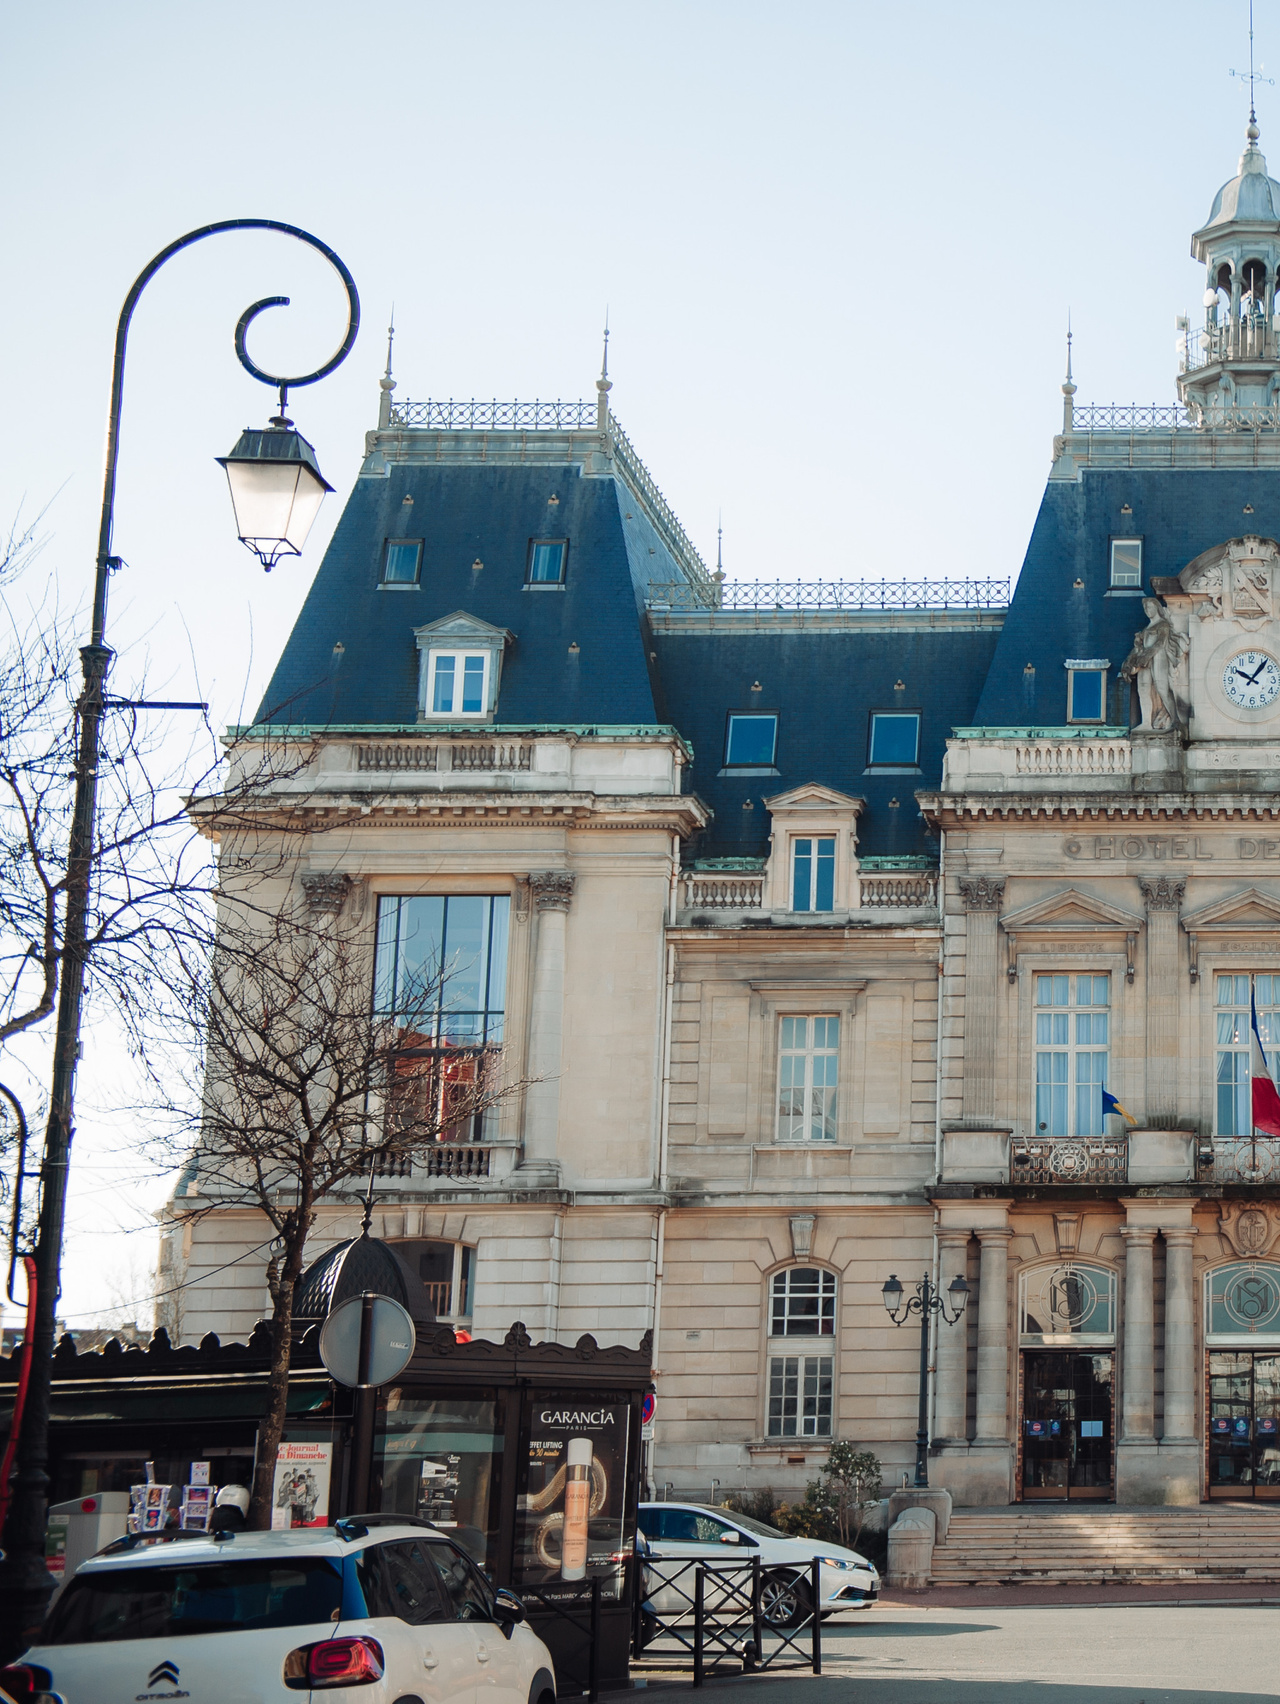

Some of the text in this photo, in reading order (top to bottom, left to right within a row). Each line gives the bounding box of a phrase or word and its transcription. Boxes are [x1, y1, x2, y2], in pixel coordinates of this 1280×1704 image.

[1248, 655, 1255, 663] 12
[1230, 666, 1237, 674] 10
[1267, 665, 1273, 673] 2
[1270, 676, 1276, 684] 3
[1230, 687, 1236, 695] 8
[1239, 694, 1245, 702] 7
[1250, 697, 1255, 705] 6
[1260, 694, 1265, 702] 5
[1205, 752, 1241, 766] 1876
[1094, 836, 1213, 860] HOTEL
[540, 1408, 615, 1424] GARANCIA
[286, 1444, 319, 1452] Journal
[286, 1452, 328, 1460] Dimanche
